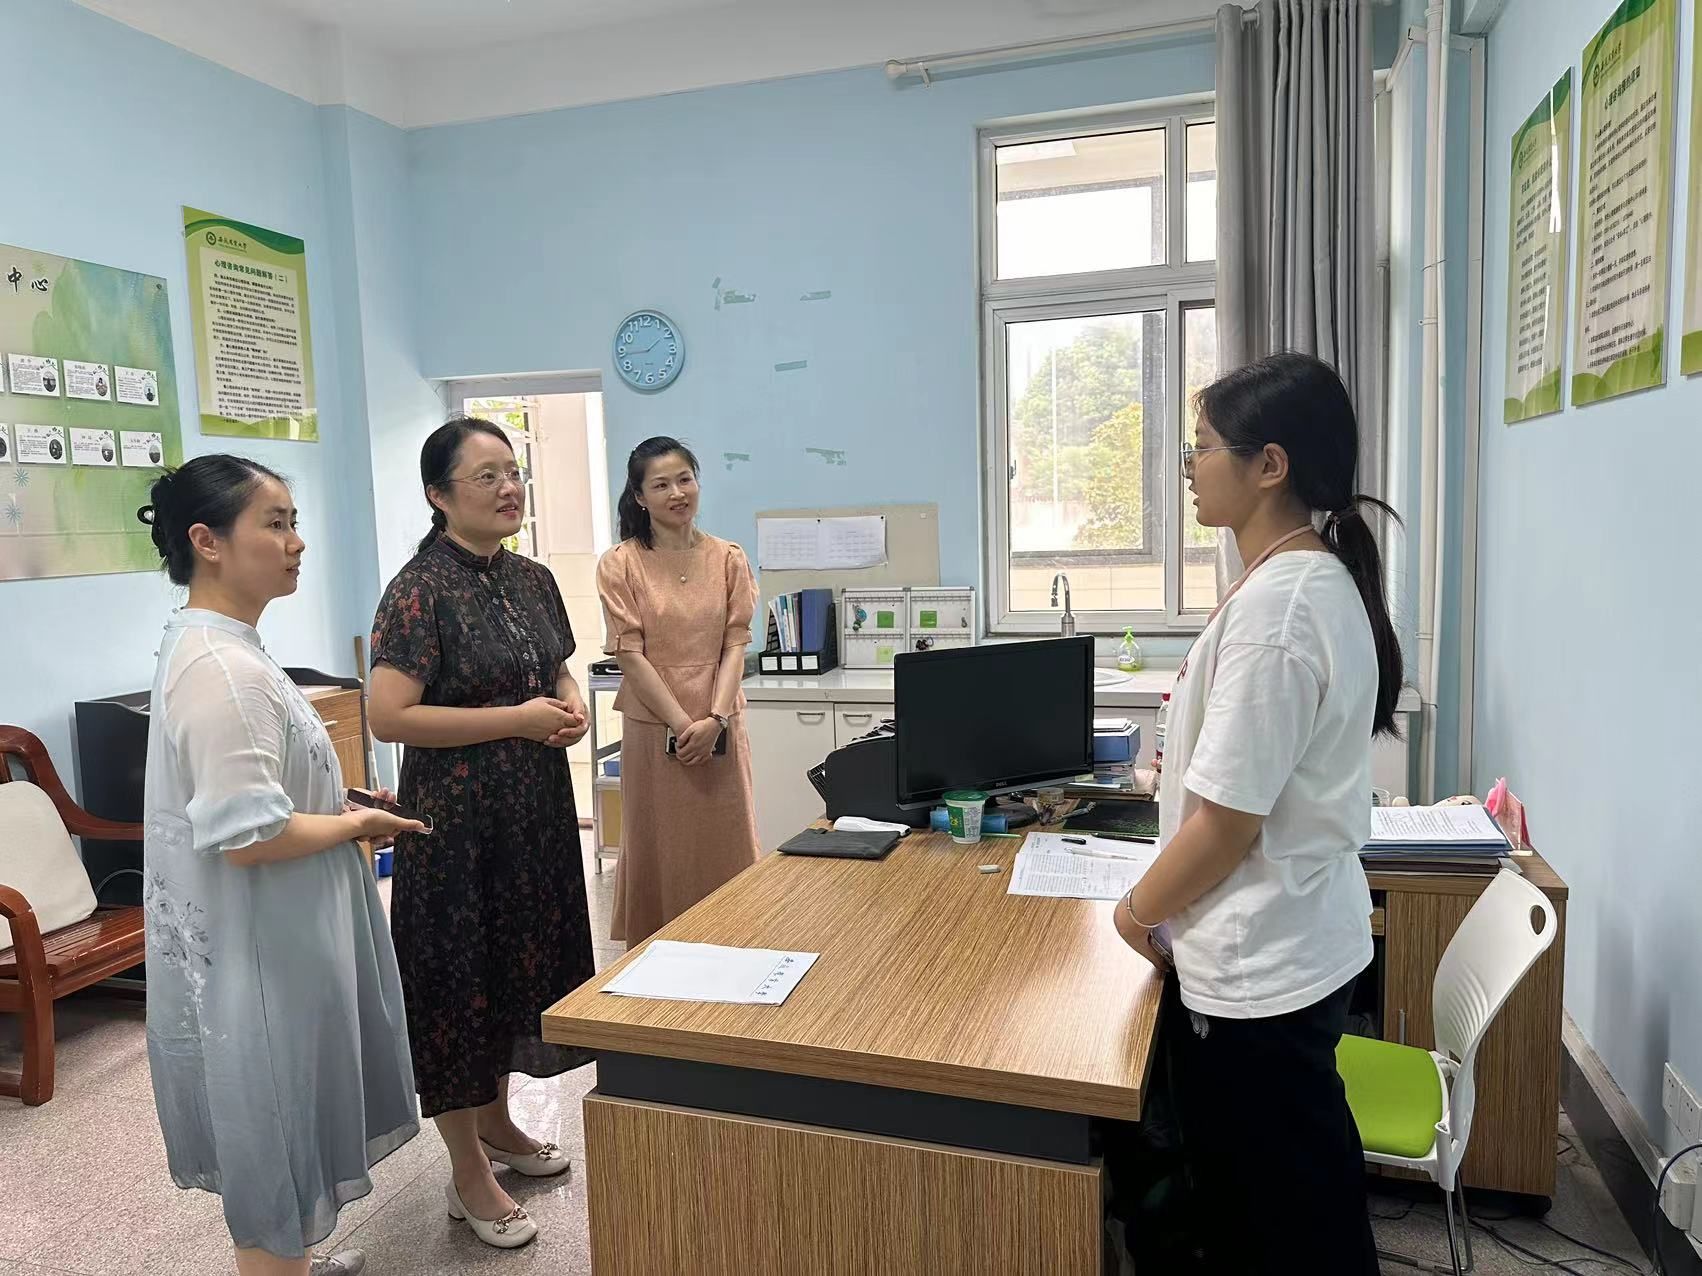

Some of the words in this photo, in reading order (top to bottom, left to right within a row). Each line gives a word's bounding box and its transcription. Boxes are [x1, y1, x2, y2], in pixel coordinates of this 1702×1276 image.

[8, 266, 48, 292] 中心
[628, 321, 638, 332] 11
[638, 316, 651, 327] 12
[655, 319, 661, 329] 1
[620, 332, 633, 343] 10
[663, 327, 673, 338] 2
[618, 346, 626, 357] 9
[668, 342, 677, 353] 3
[623, 360, 633, 371] 8
[665, 356, 673, 368] 4
[633, 369, 642, 380] 7
[645, 372, 655, 383] 6
[659, 368, 667, 378] 5
